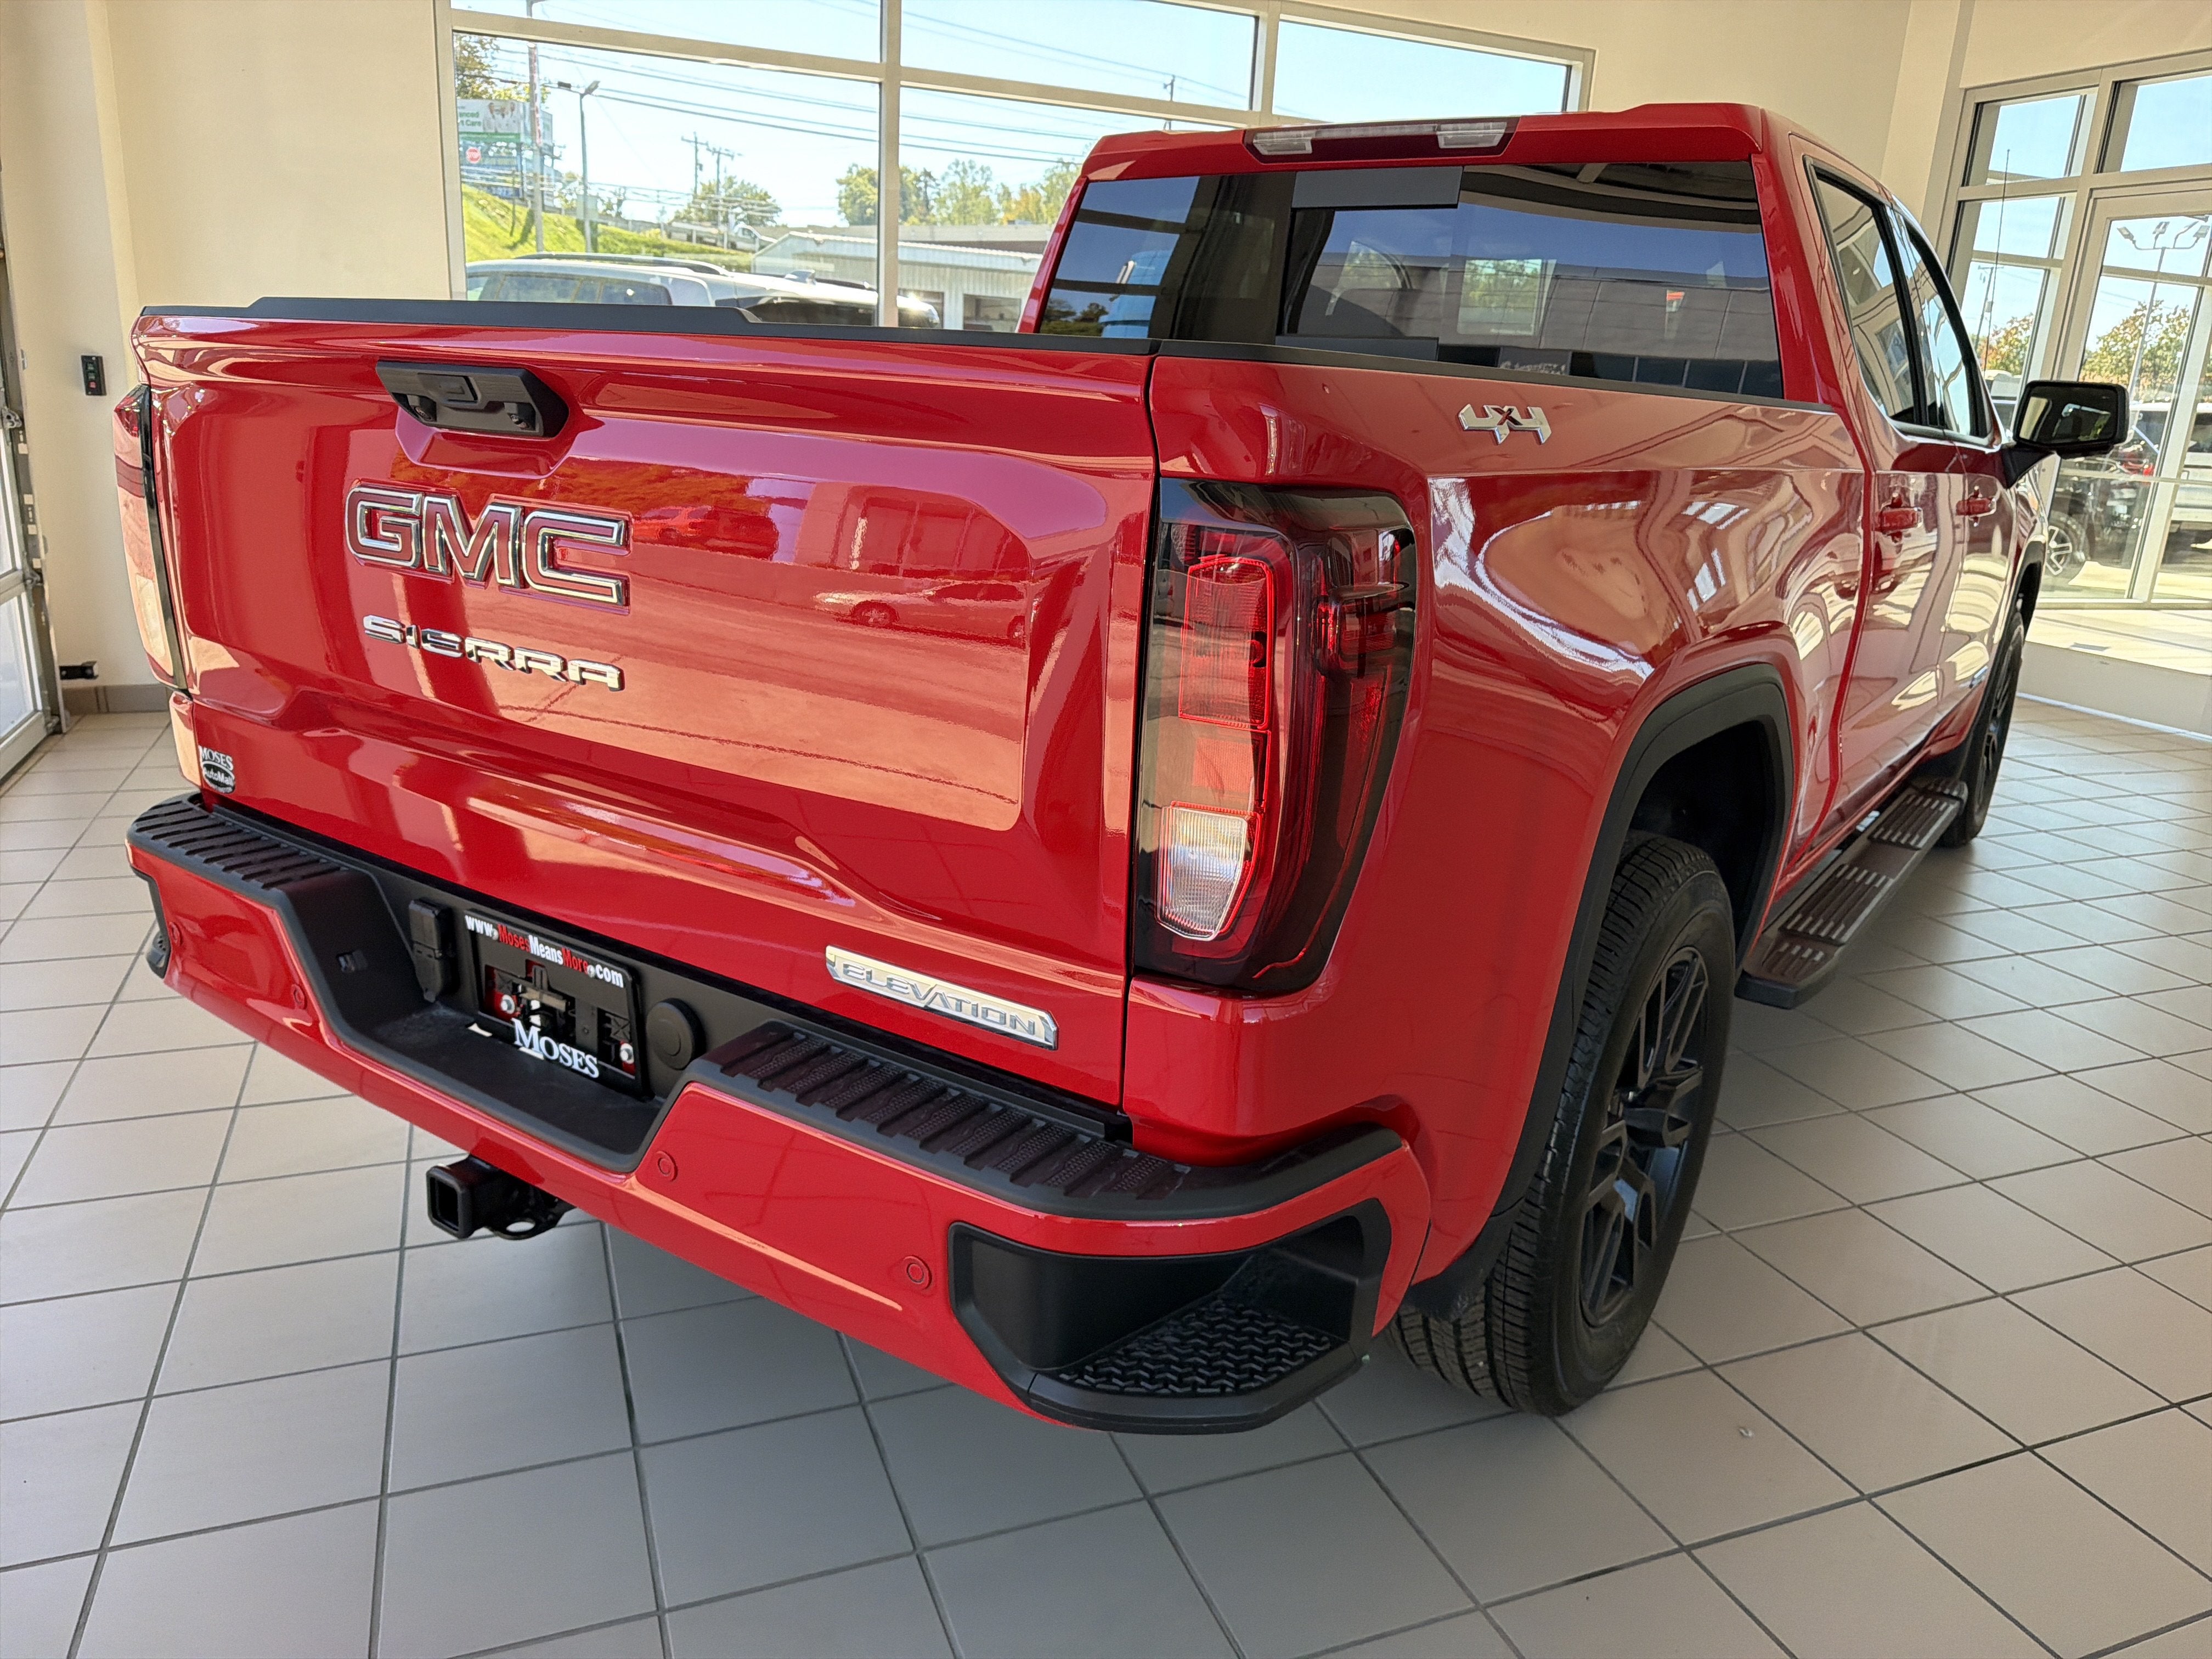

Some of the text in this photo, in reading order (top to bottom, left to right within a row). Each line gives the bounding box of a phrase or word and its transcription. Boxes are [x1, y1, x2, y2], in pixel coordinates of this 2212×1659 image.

[345, 482, 626, 606] GMC
[363, 614, 624, 692] SIERRA
[198, 745, 234, 771] MOSES
[464, 915, 624, 988] wwwMosesMeansMorecom
[842, 962, 1036, 1035] ELEVATION
[511, 1018, 600, 1079] MOSES
